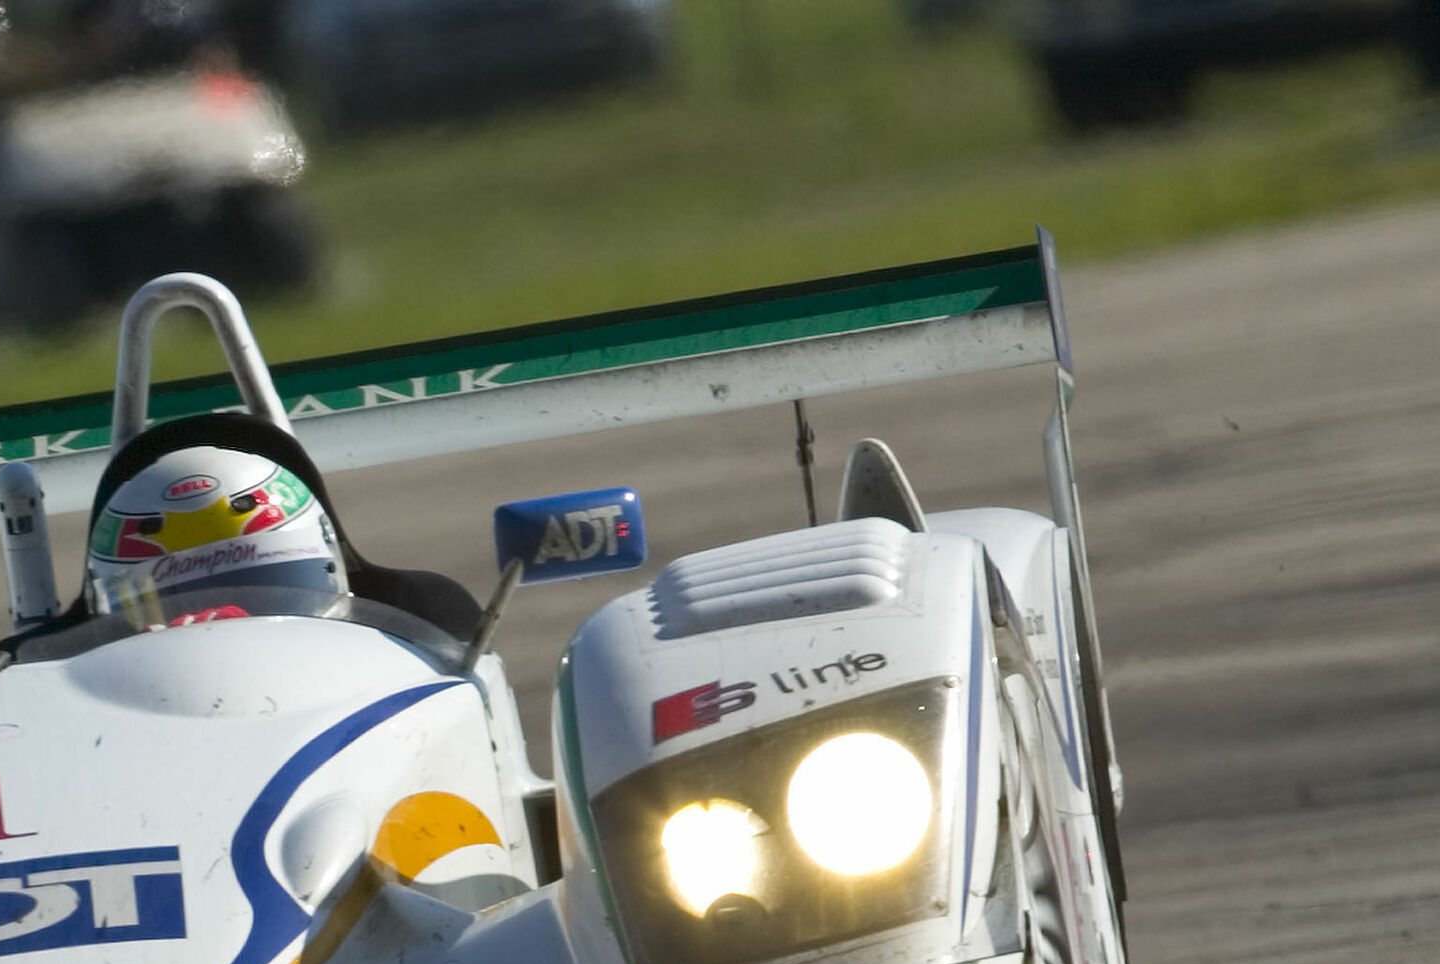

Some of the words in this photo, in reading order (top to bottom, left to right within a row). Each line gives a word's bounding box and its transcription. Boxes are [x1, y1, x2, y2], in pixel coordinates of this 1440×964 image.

[212, 363, 514, 420] ANK
[534, 505, 623, 564] ADT
[152, 542, 257, 582] Champion
[770, 652, 887, 693] line
